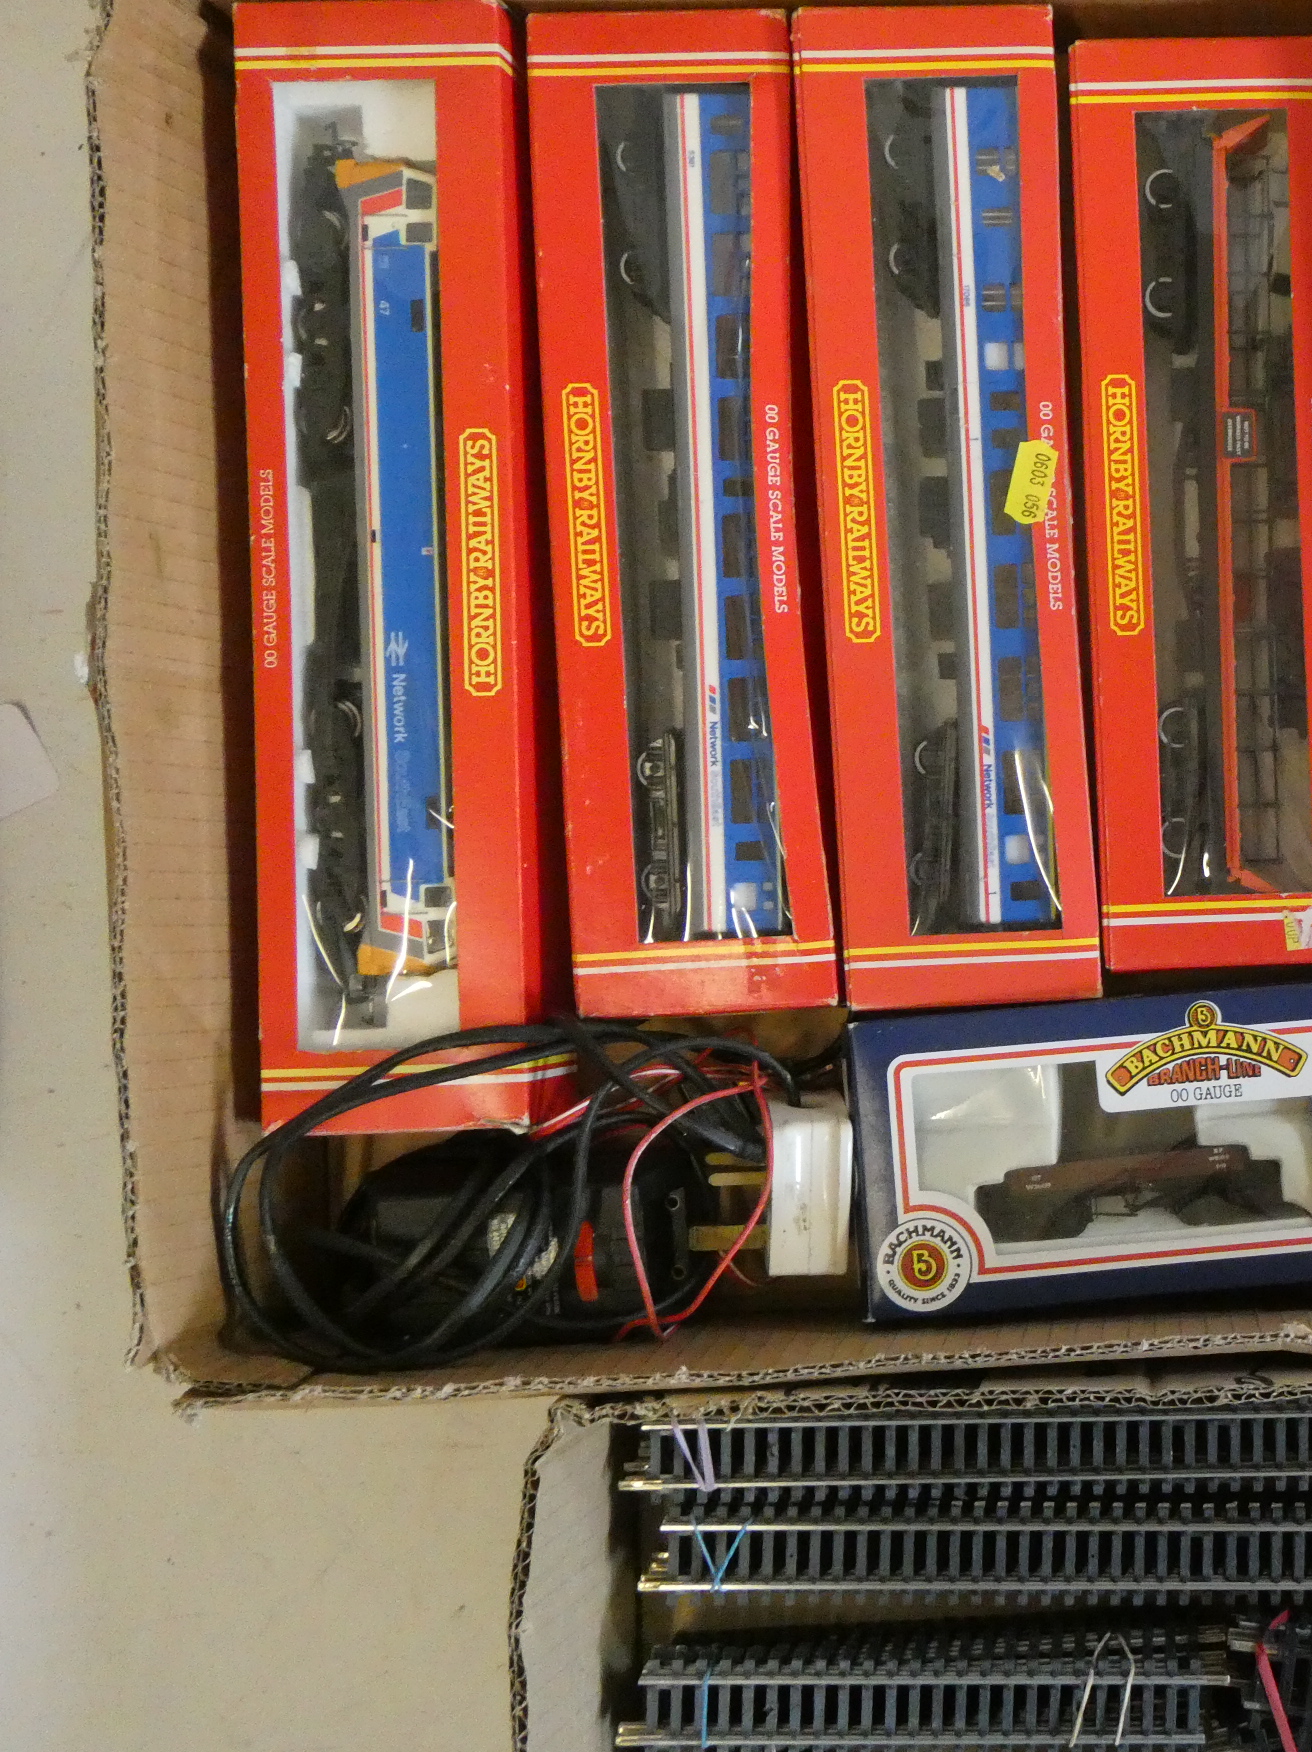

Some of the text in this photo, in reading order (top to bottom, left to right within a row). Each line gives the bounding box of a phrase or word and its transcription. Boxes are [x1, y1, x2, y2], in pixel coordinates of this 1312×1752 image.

[765, 427, 781, 486] GAUGE
[1029, 453, 1051, 487] 0603
[259, 469, 273, 533] MODELS
[568, 395, 605, 637] HORNBY RAILWAYS
[769, 488, 783, 540] SCALE
[839, 391, 874, 633] HORNBY RAILWAYS
[1021, 493, 1040, 519] 056
[1045, 487, 1058, 538] SCALE
[1108, 387, 1138, 626] HORNBY RAILWAYS
[261, 536, 275, 586] SCALE
[466, 439, 496, 686] HORNBY RAILWAYS
[771, 544, 789, 614] MODELS
[1046, 544, 1063, 610] MODELS
[263, 591, 277, 648] GAUGE
[391, 673, 408, 743] Network
[709, 721, 719, 766] Network
[983, 763, 994, 809] Network
[1123, 1029, 1284, 1076] BACHMANN
[1193, 1083, 1243, 1101] GAUGE
[882, 1224, 964, 1266] BACHMANN
[888, 1279, 920, 1304] QUALITY
[921, 1291, 947, 1305] SINCE
